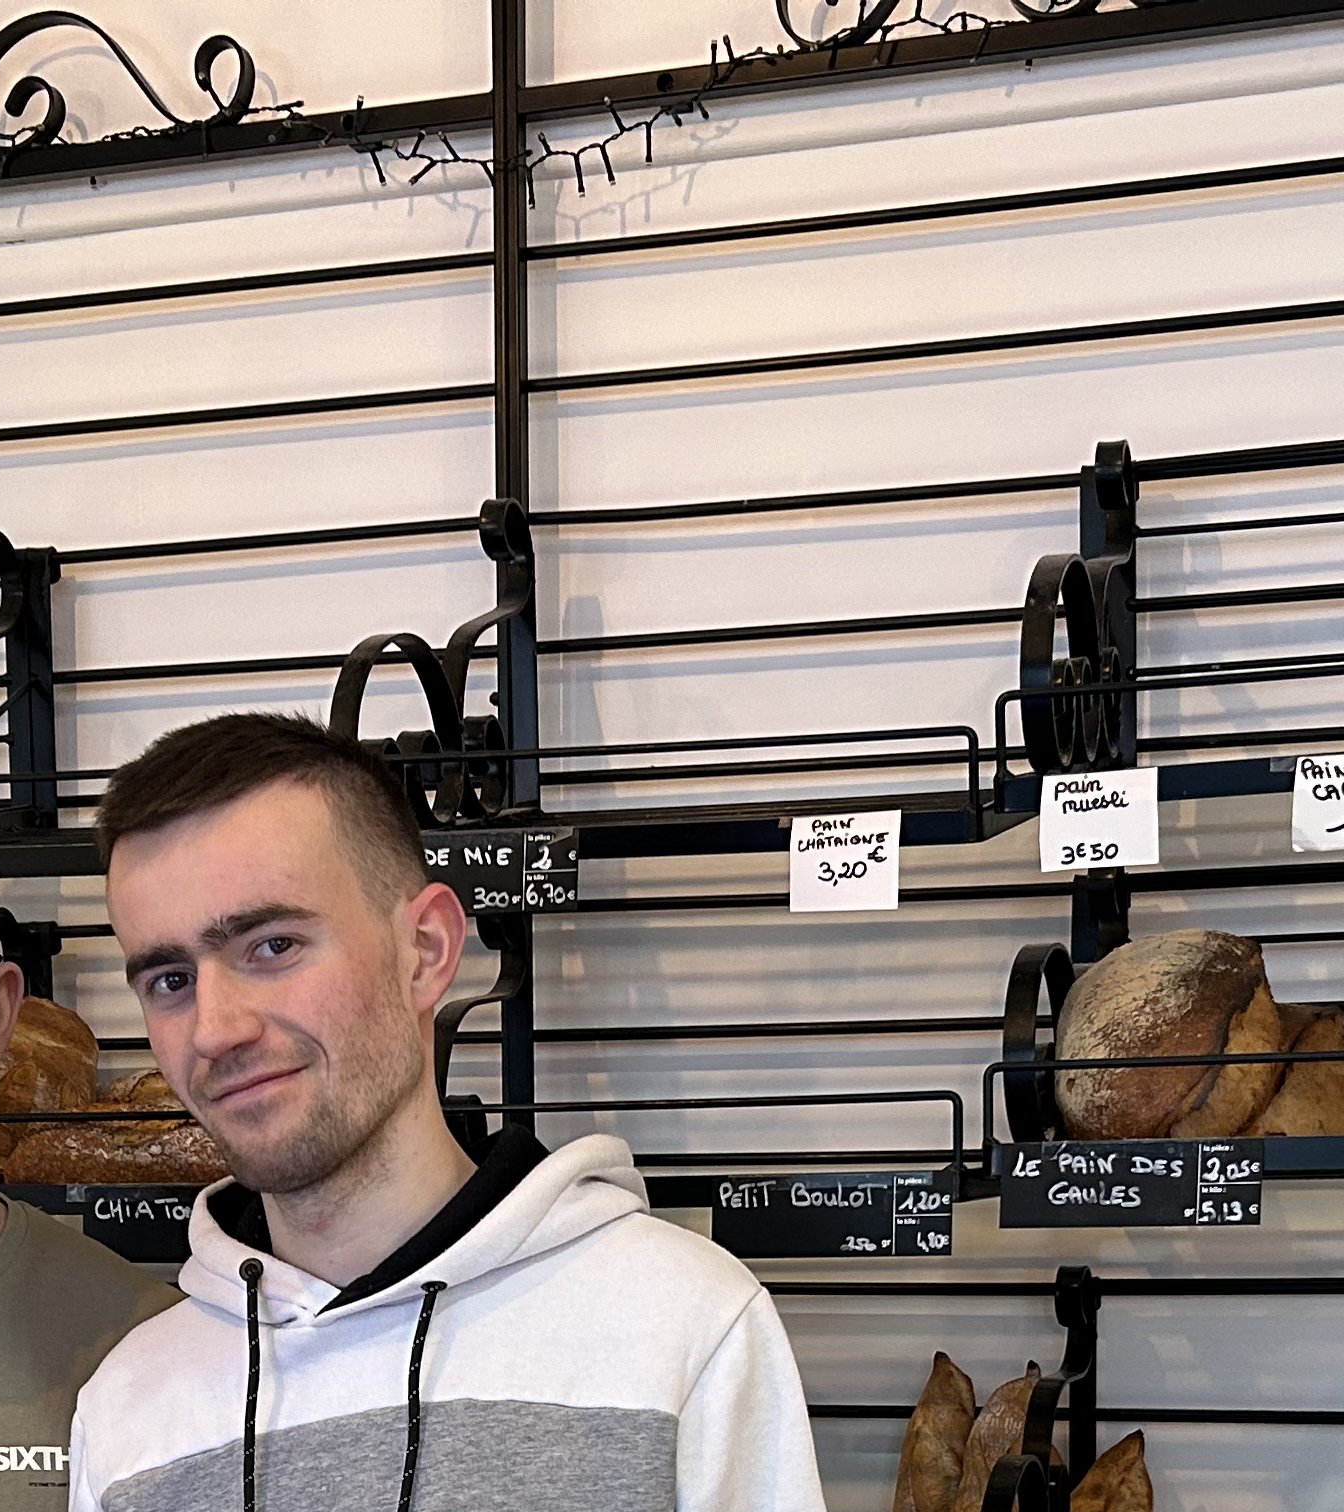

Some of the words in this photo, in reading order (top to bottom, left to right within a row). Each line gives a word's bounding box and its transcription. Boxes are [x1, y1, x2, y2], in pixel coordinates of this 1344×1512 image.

[1054, 774, 1103, 801] pain
[1062, 790, 1129, 814] muesli
[811, 817, 855, 832] PAIN
[424, 848, 450, 866] DE
[532, 846, 552, 870] 2
[474, 887, 509, 909] 300
[1012, 1152, 1042, 1177] LE
[1130, 1156, 1184, 1178] DES
[1047, 1181, 1141, 1208] GAULES
